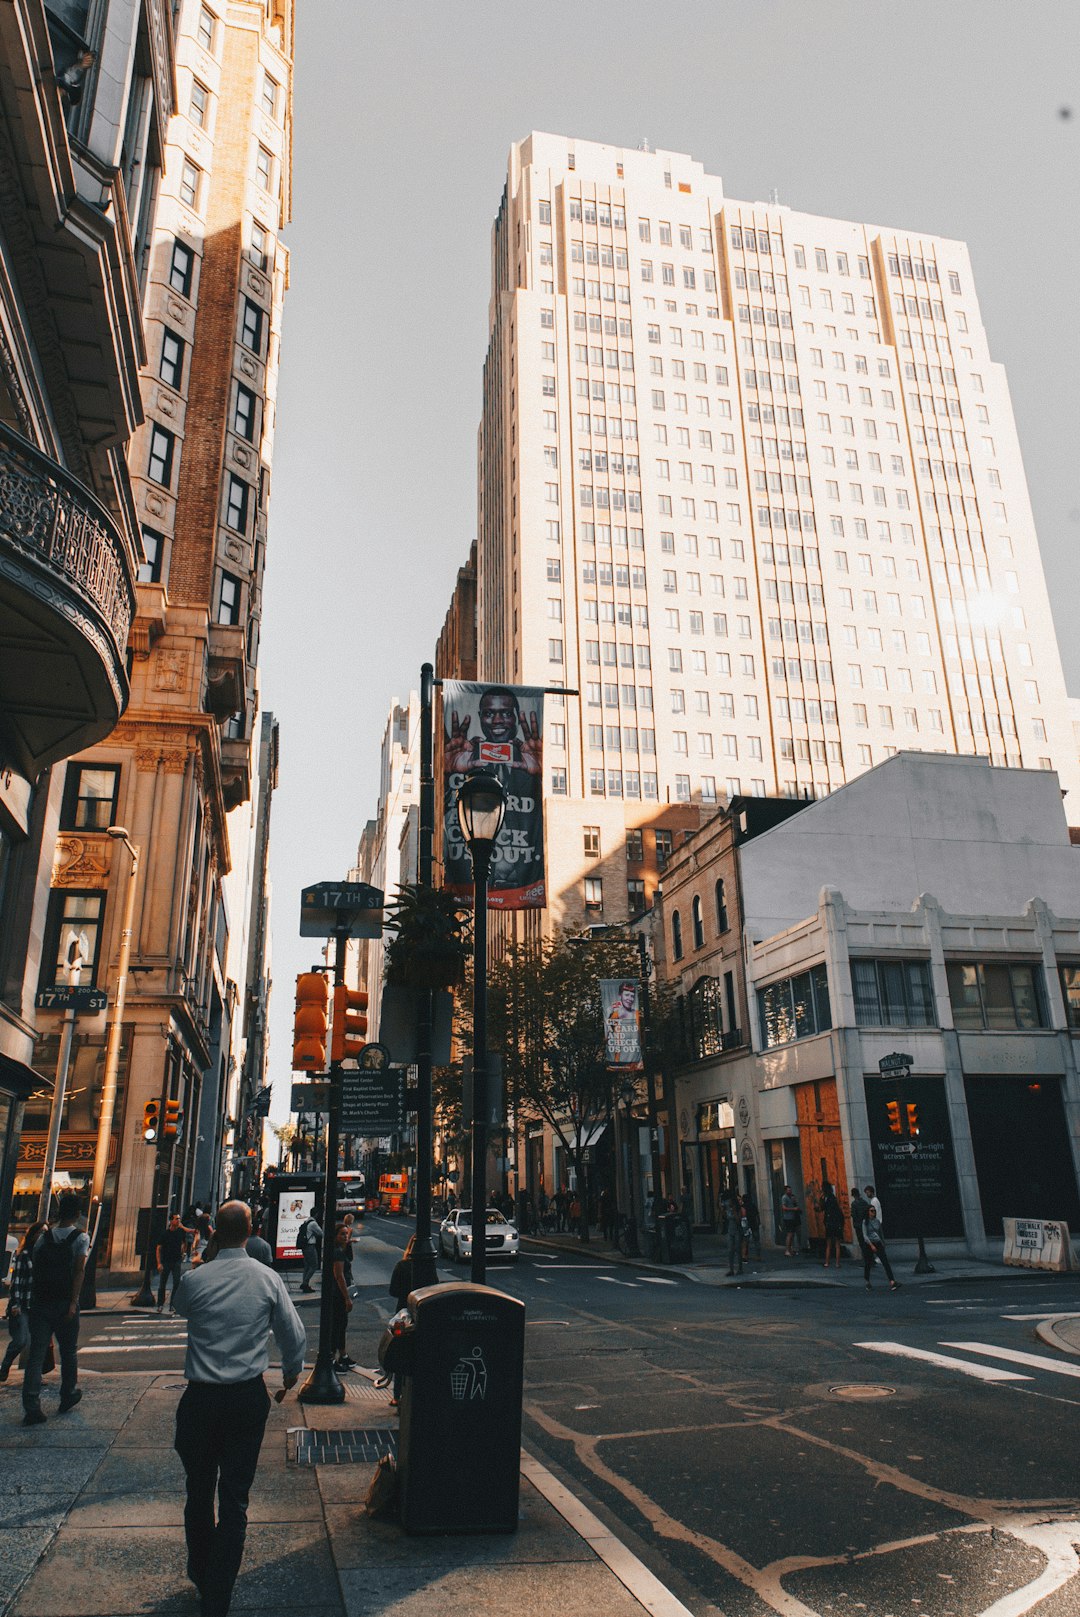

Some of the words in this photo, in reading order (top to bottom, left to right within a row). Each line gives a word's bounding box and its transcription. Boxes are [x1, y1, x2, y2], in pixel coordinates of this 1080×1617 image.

[447, 825, 529, 847] CCK
[489, 846, 541, 864] OUT.
[368, 898, 380, 908] ST
[89, 998, 105, 1008] ST
[606, 1018, 623, 1026] GET
[1016, 1222, 1041, 1230] SIDEWALK
[1021, 1239, 1037, 1247] AHEAD
